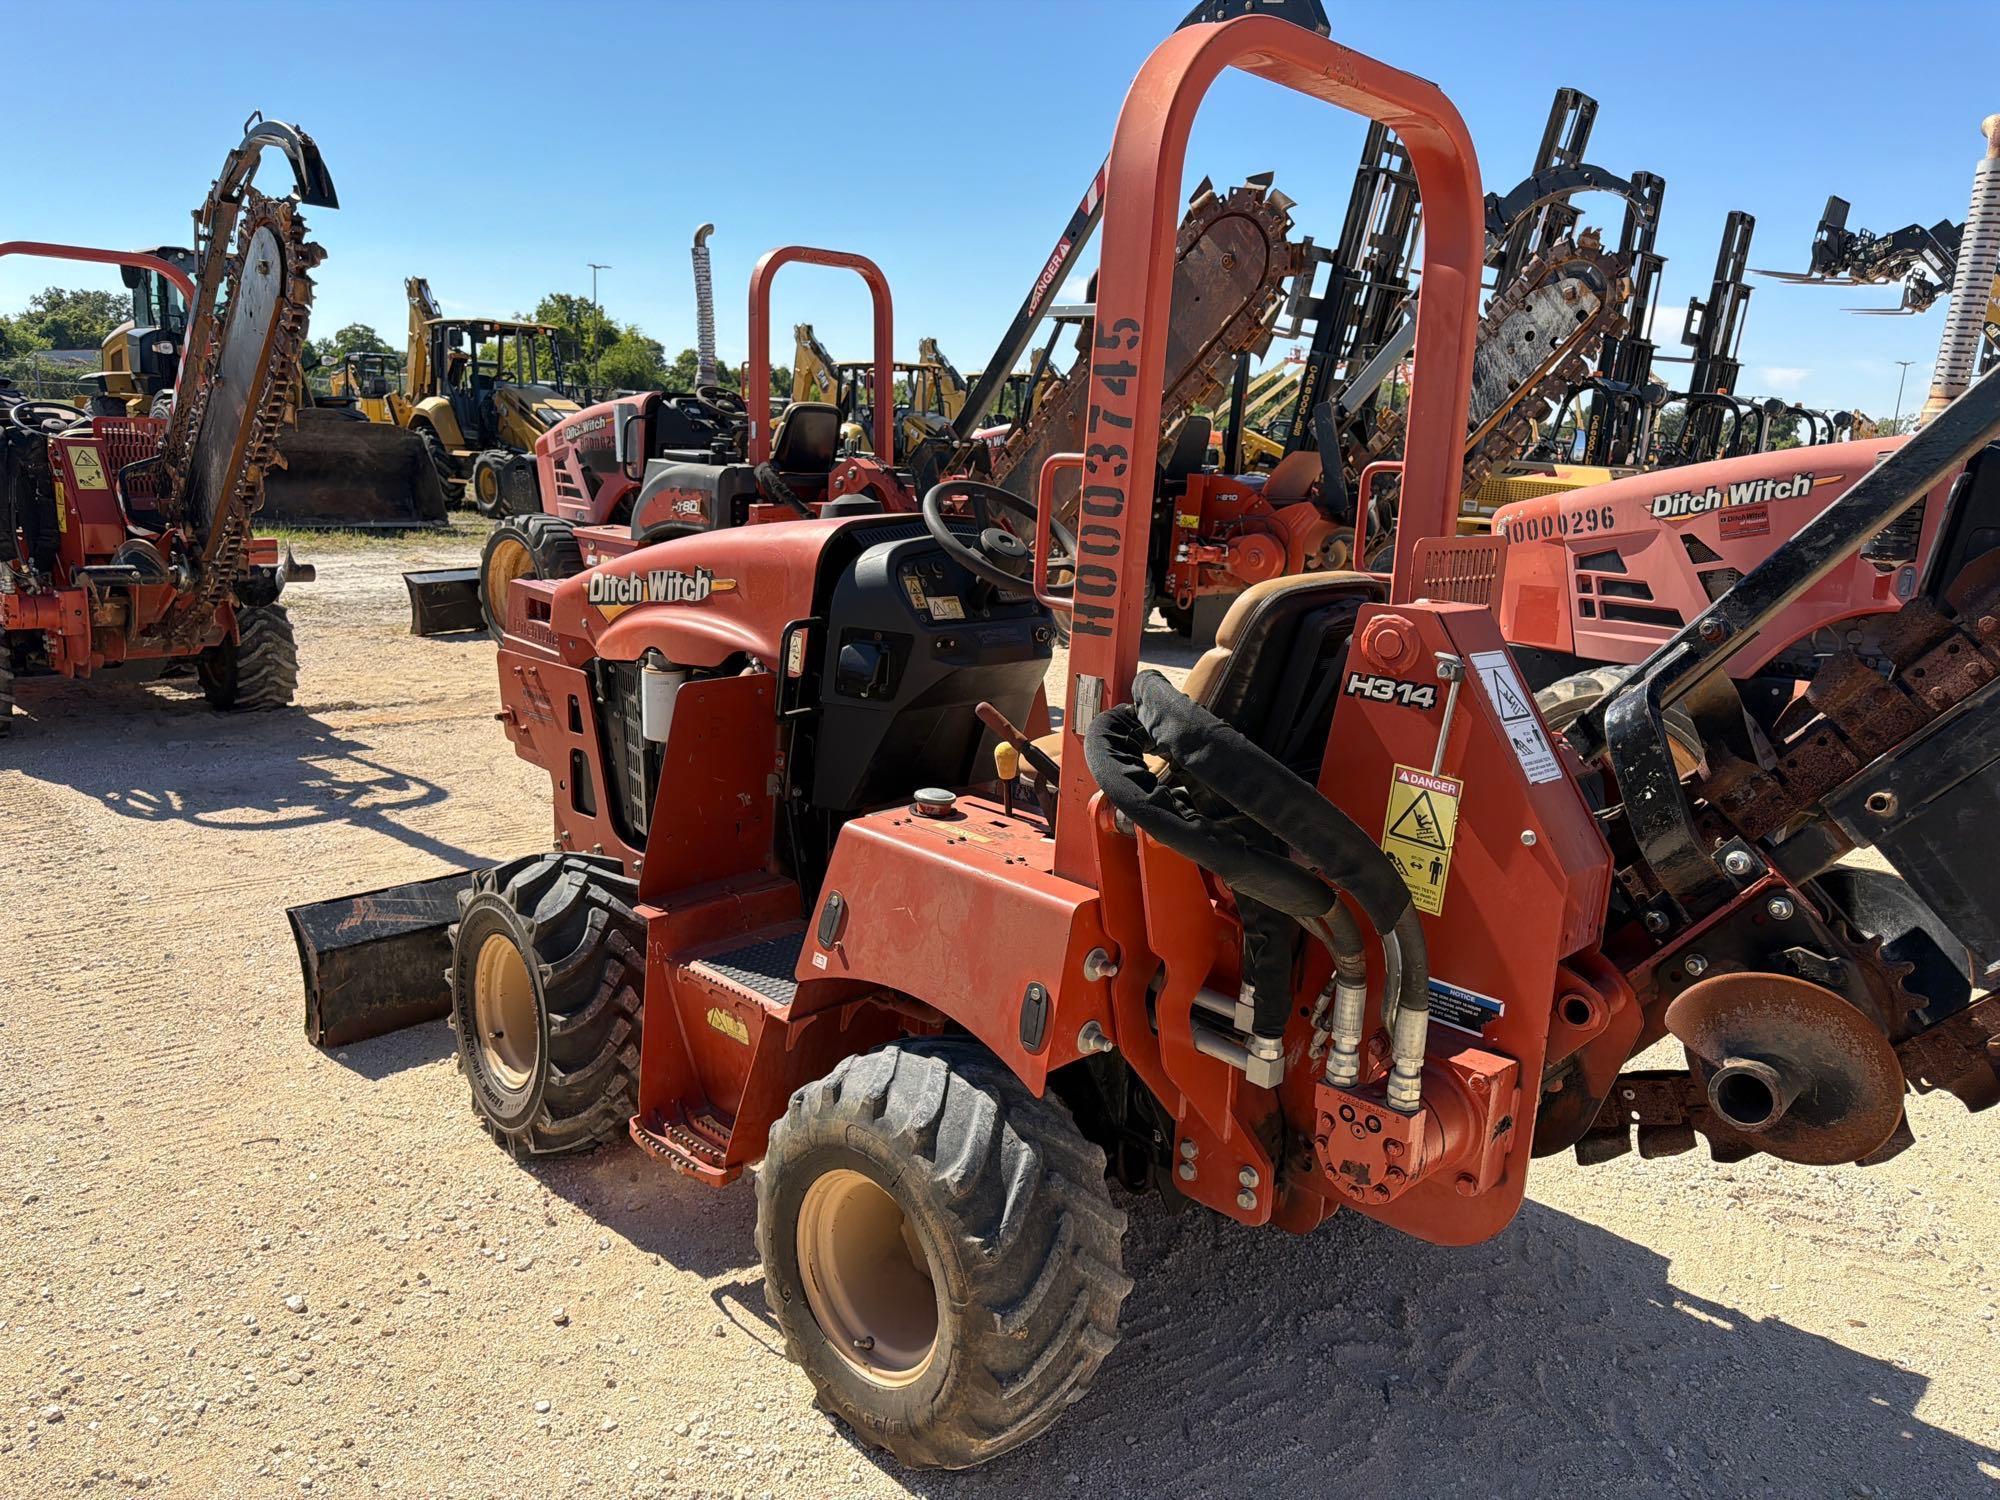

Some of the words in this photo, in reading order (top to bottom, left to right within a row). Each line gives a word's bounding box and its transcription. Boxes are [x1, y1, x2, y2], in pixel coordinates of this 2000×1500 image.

[1072, 317, 1141, 637] H0003745
[1653, 487, 1721, 517] Ditch
[1730, 474, 1810, 505] Witch
[589, 570, 643, 602] Ditch
[648, 569, 710, 601] Witch
[1347, 674, 1435, 708] H314
[1410, 774, 1456, 794] DANGER
[1449, 989, 1476, 1003] NOTICE
